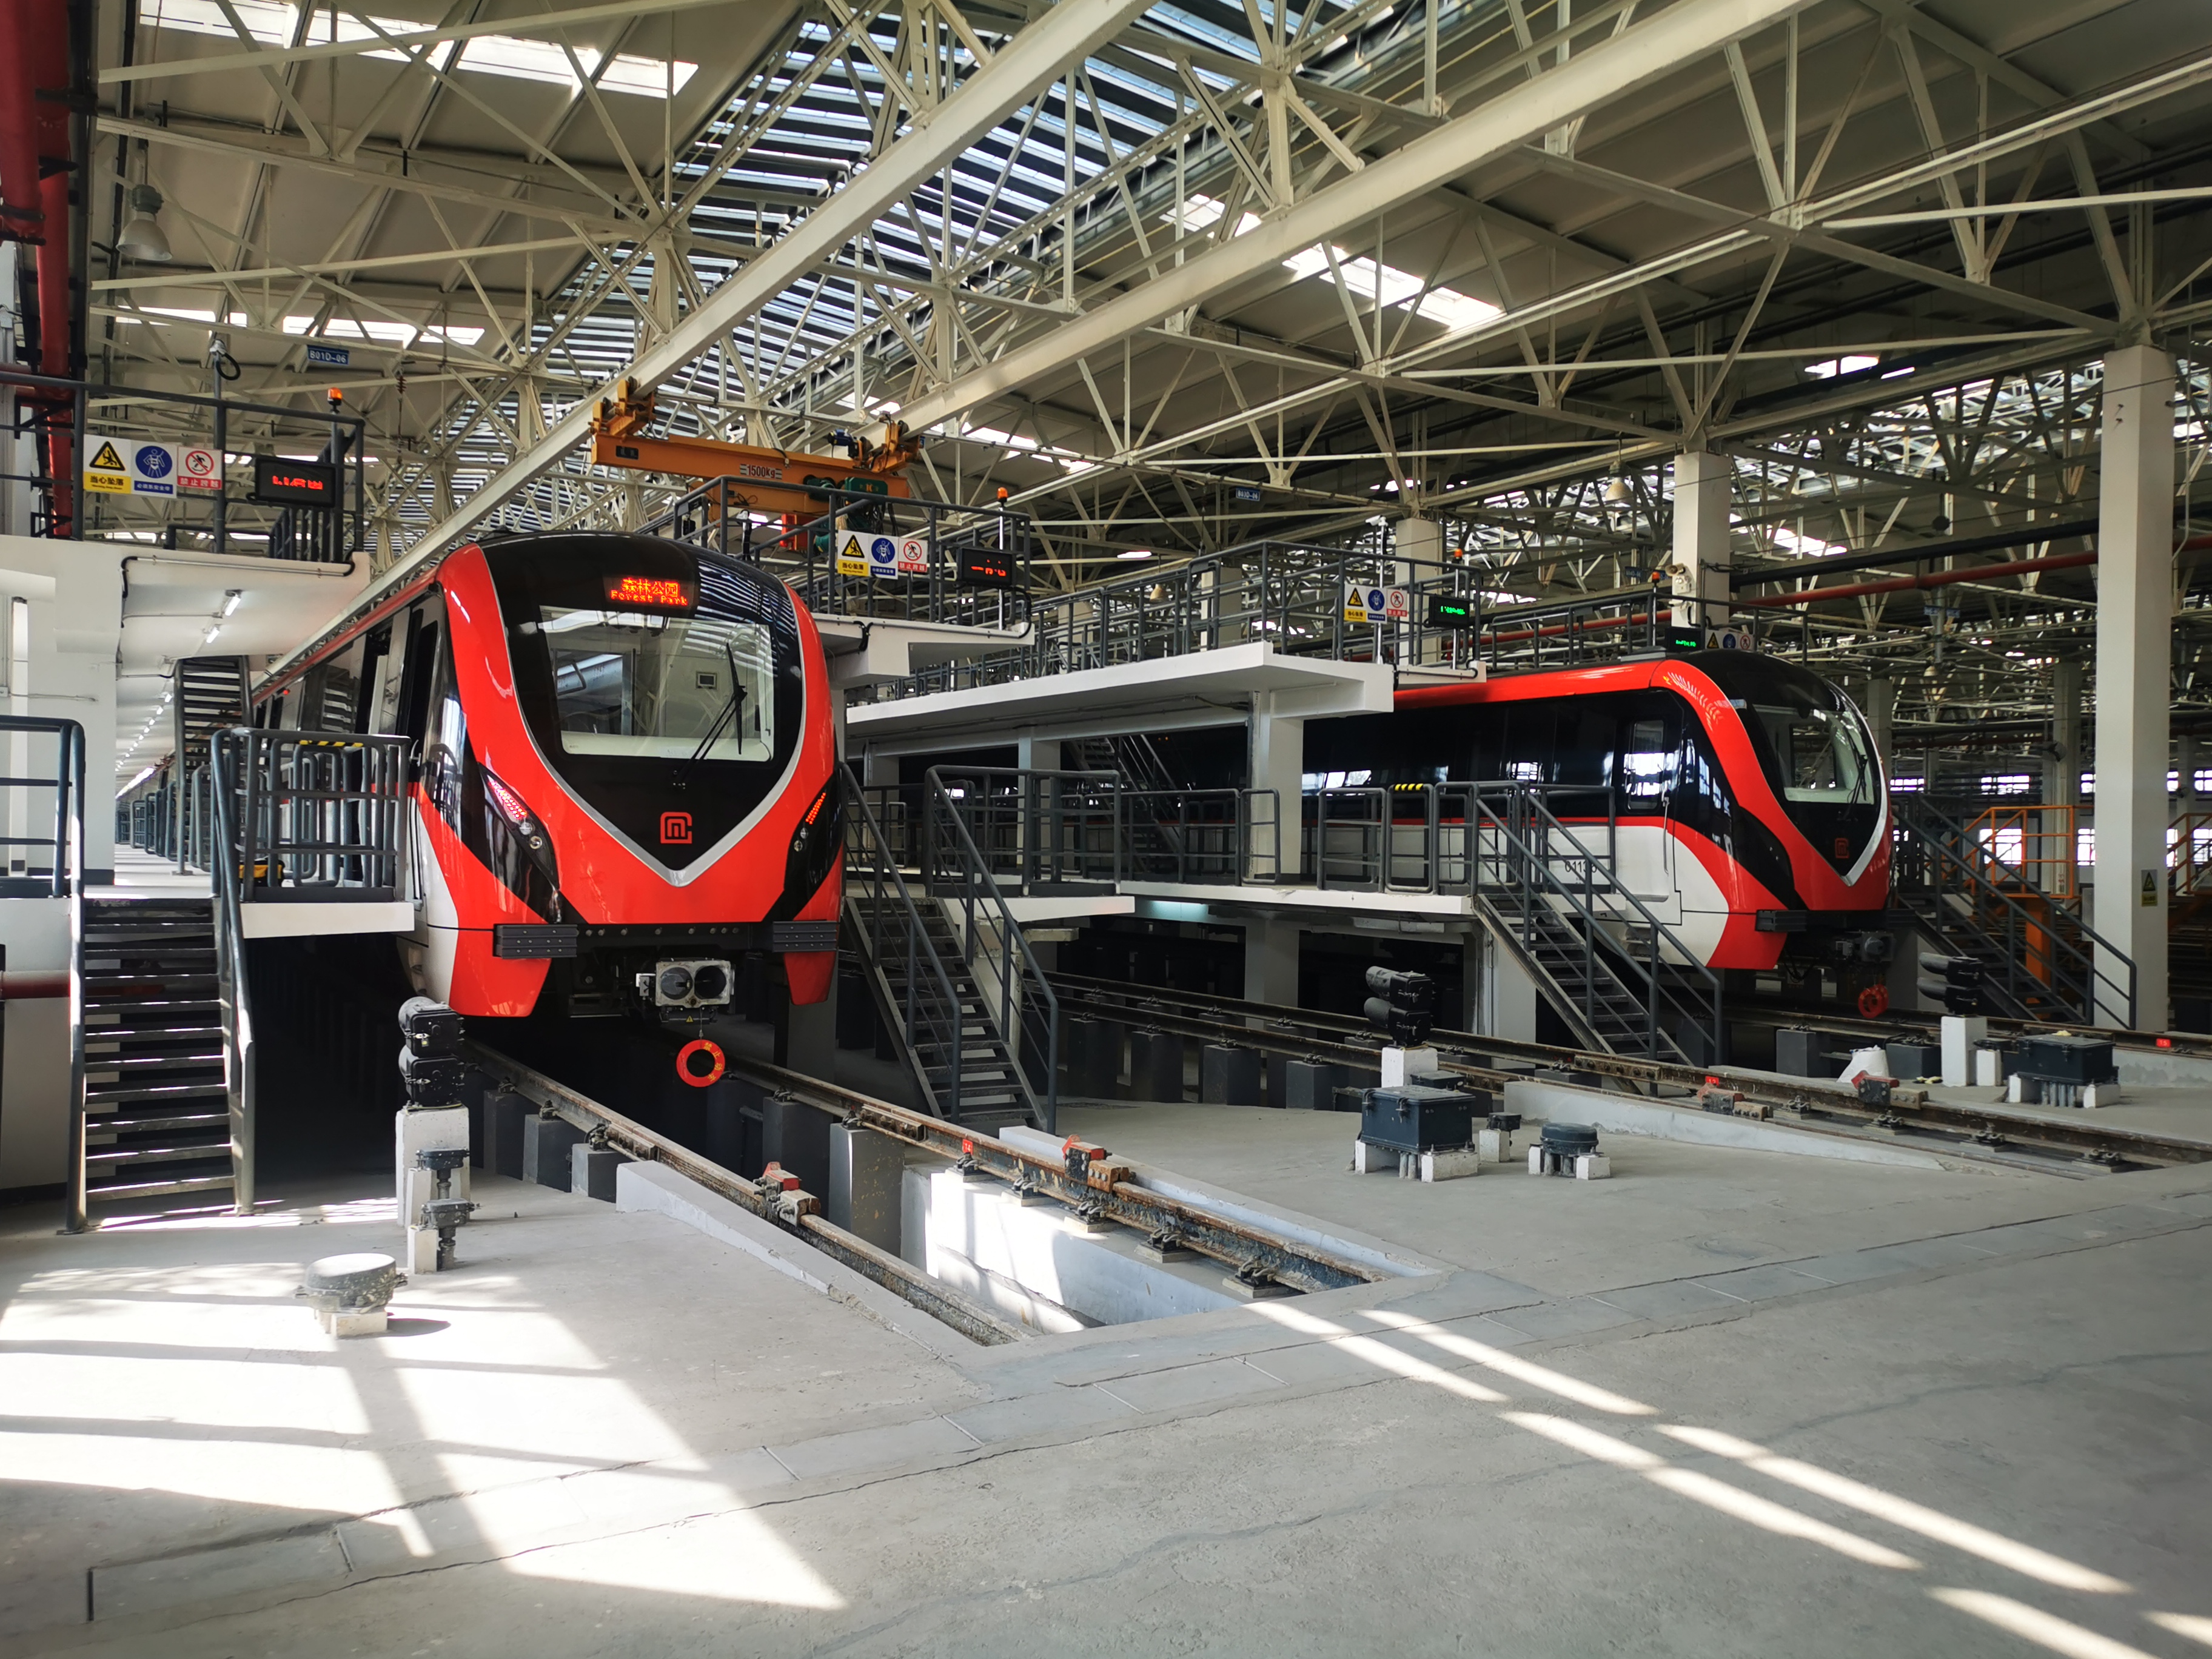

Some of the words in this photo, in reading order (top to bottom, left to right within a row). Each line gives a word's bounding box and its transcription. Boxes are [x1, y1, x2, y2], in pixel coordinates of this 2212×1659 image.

[747, 464, 776, 478] 1500kg
[90, 475, 124, 486] 当心坠落
[622, 577, 679, 597] 森林公园
[611, 589, 653, 603] Forest
[661, 595, 688, 606] Park
